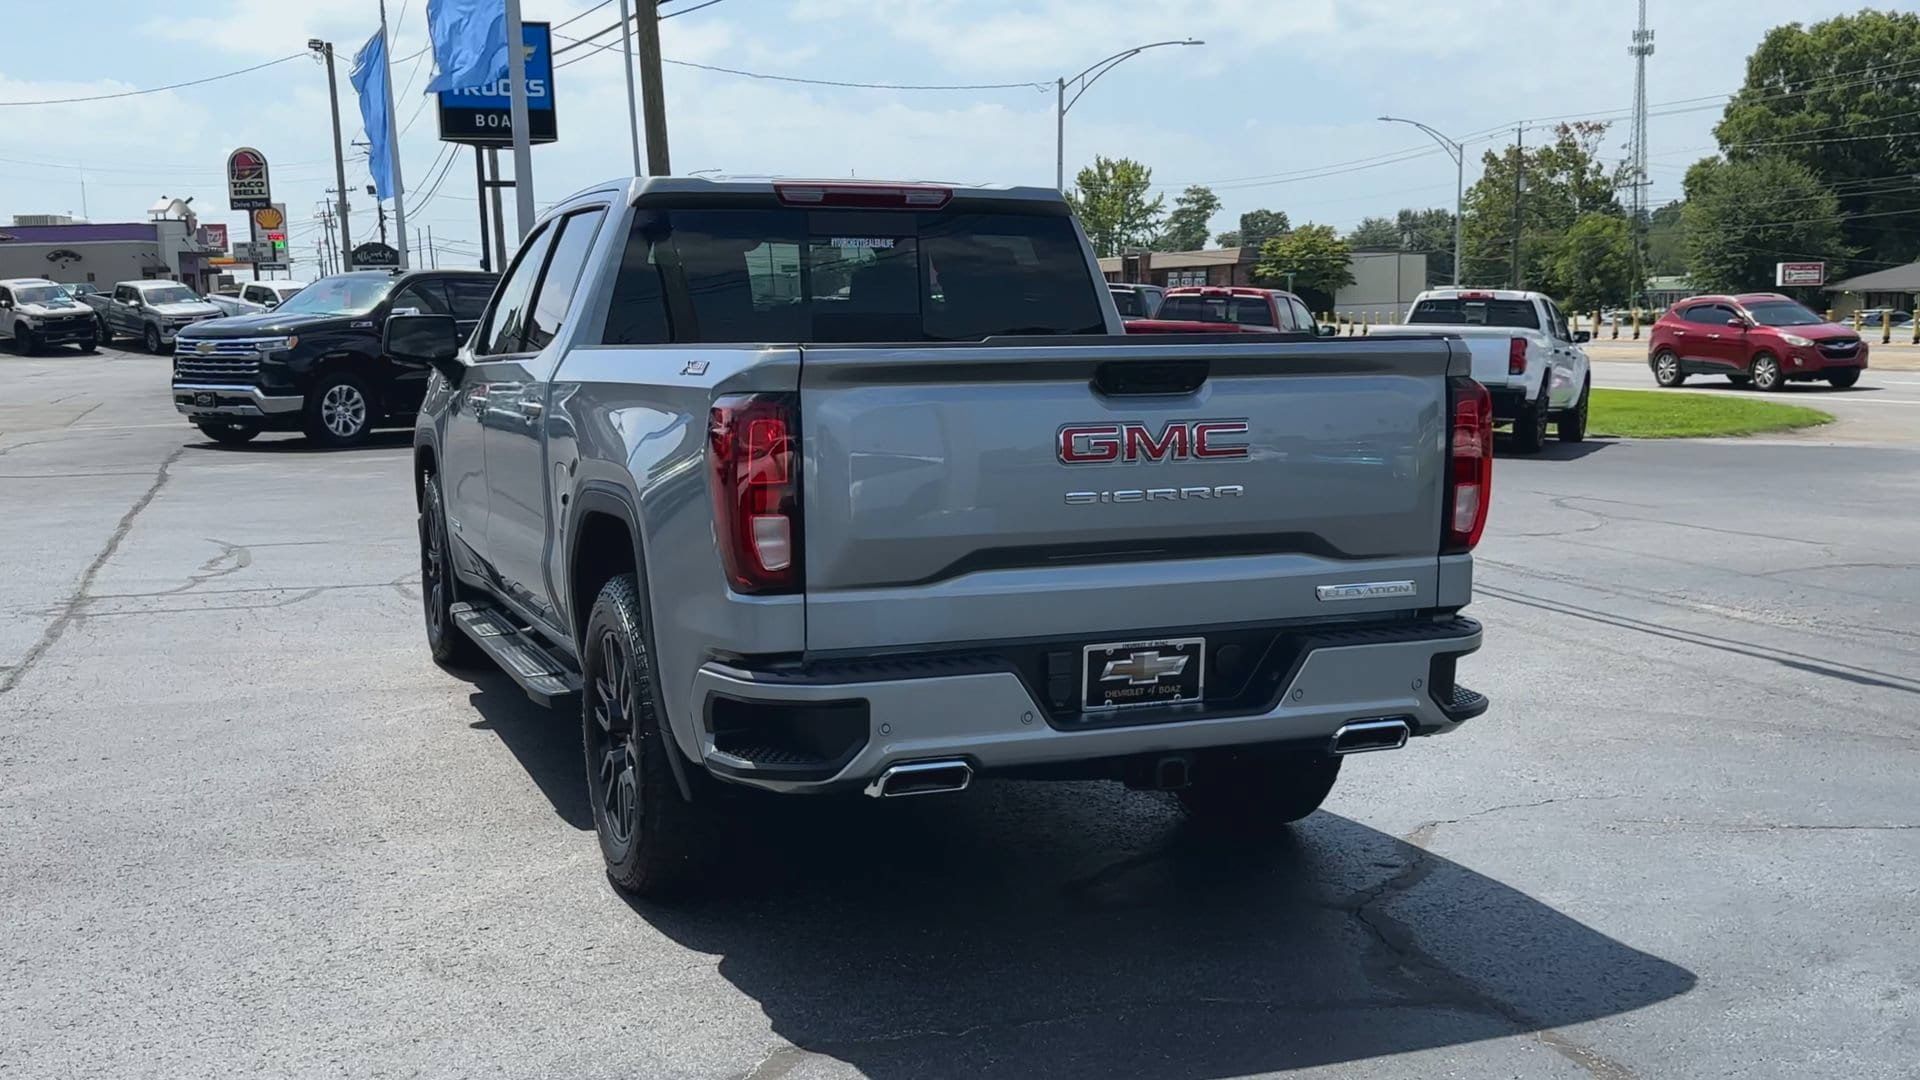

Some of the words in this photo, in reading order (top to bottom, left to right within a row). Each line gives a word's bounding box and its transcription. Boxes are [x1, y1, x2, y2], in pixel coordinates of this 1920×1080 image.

[1057, 420, 1249, 466] GMC
[1064, 485, 1244, 505] SIERRA
[1325, 585, 1410, 598] ELEVATION
[1104, 687, 1145, 699] CHEVROLET
[1158, 684, 1182, 694] BOAZ
